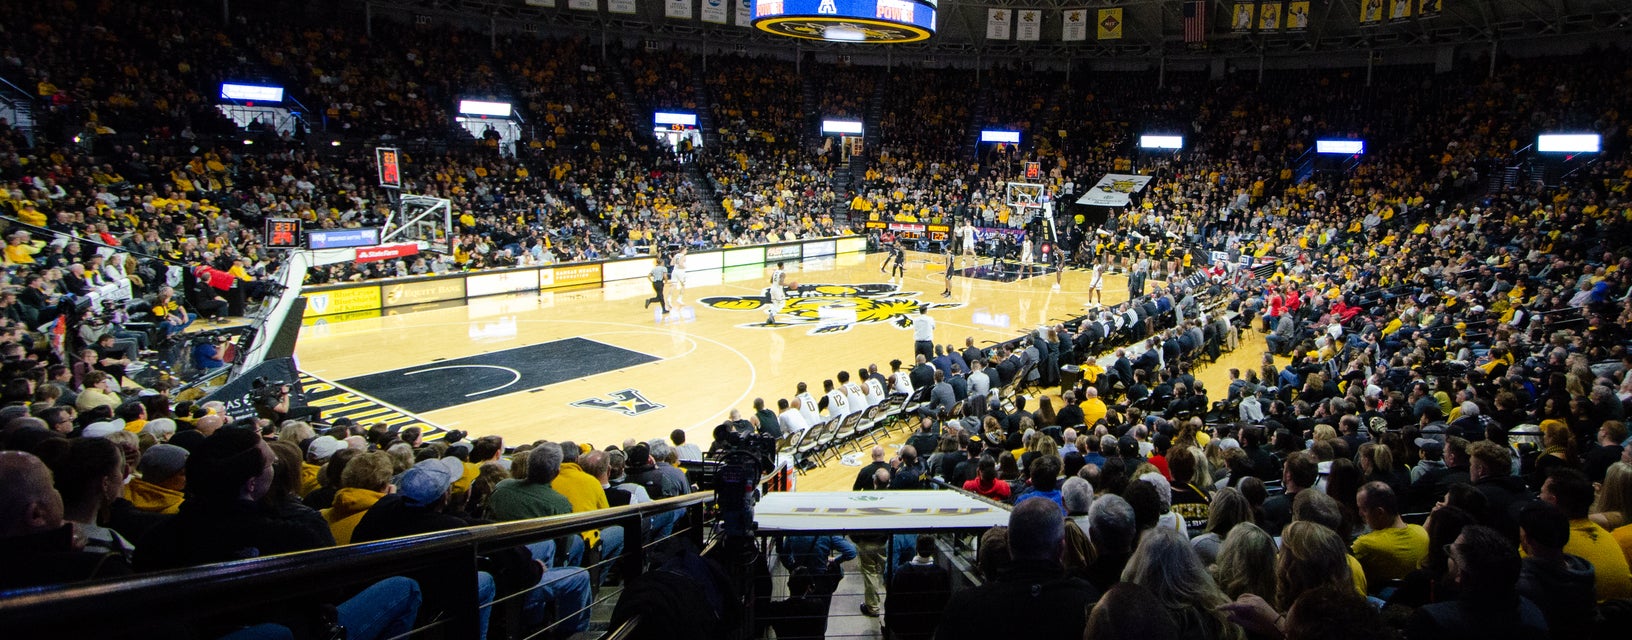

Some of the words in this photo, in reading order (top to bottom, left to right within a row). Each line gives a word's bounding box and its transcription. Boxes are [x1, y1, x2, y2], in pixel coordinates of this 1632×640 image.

[876, 6, 914, 23] POWER
[806, 400, 815, 412] 0
[833, 394, 845, 408] 12
